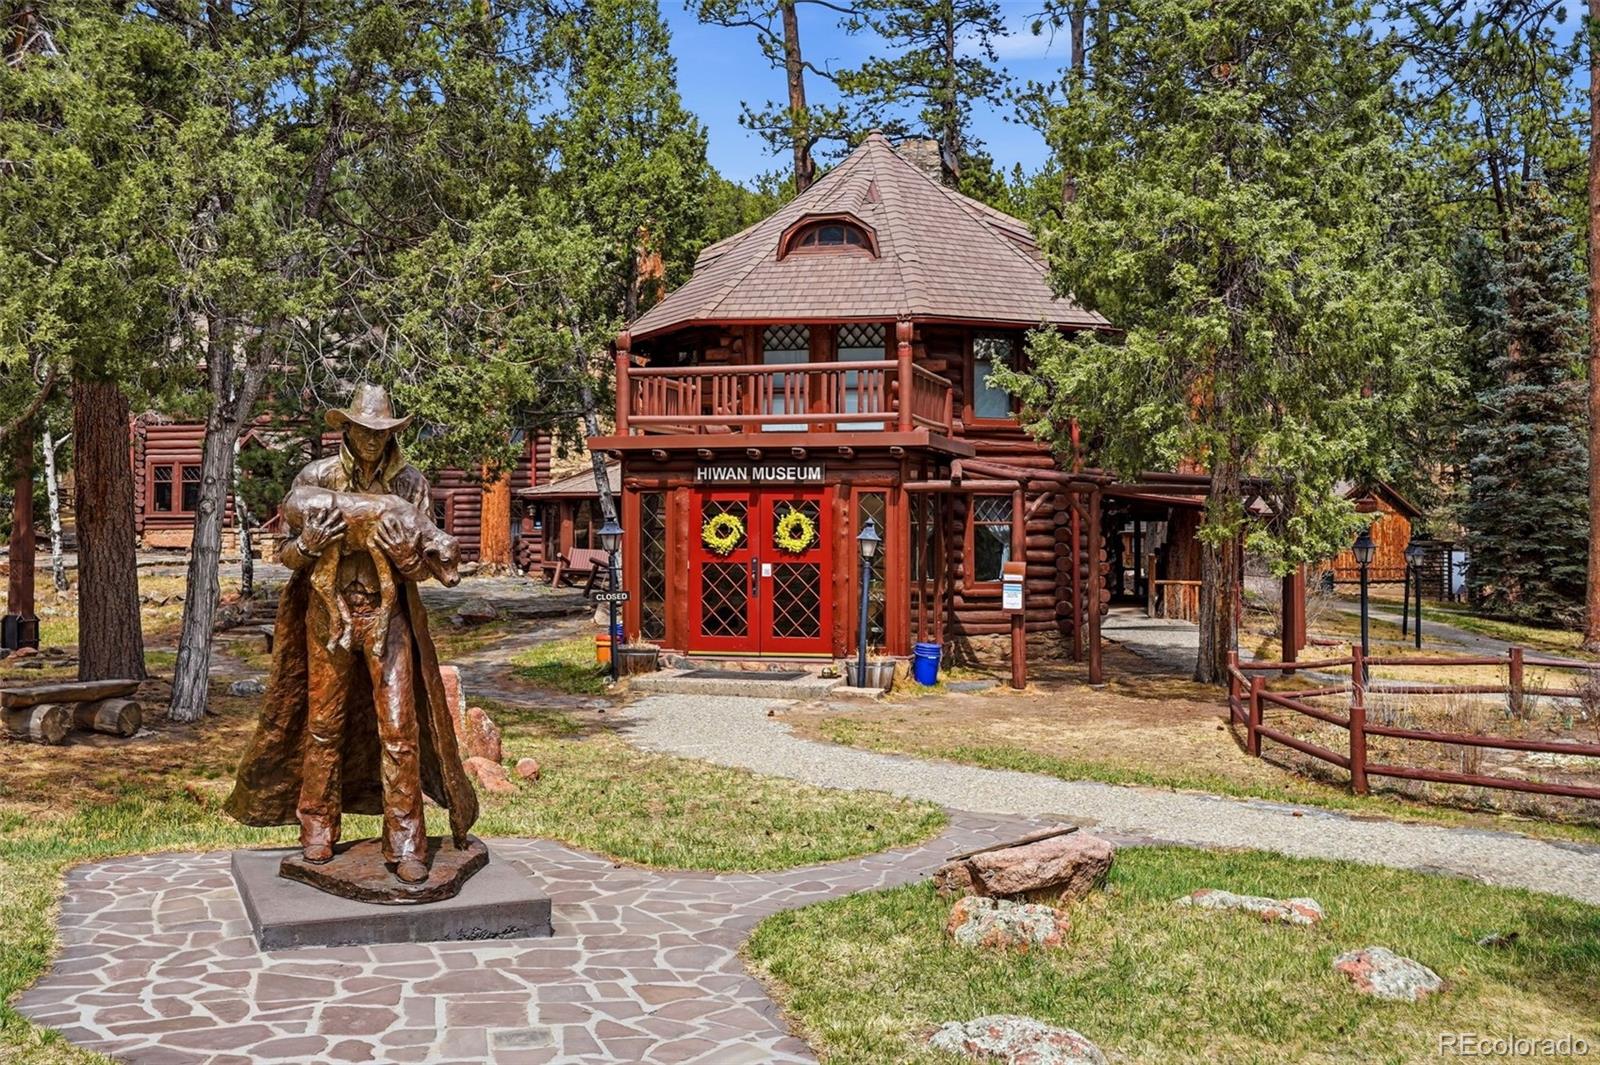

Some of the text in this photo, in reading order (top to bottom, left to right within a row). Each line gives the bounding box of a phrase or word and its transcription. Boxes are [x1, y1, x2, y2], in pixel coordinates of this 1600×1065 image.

[697, 467, 821, 480] HIWAN MUSEUM
[596, 592, 628, 601] CLOSED
